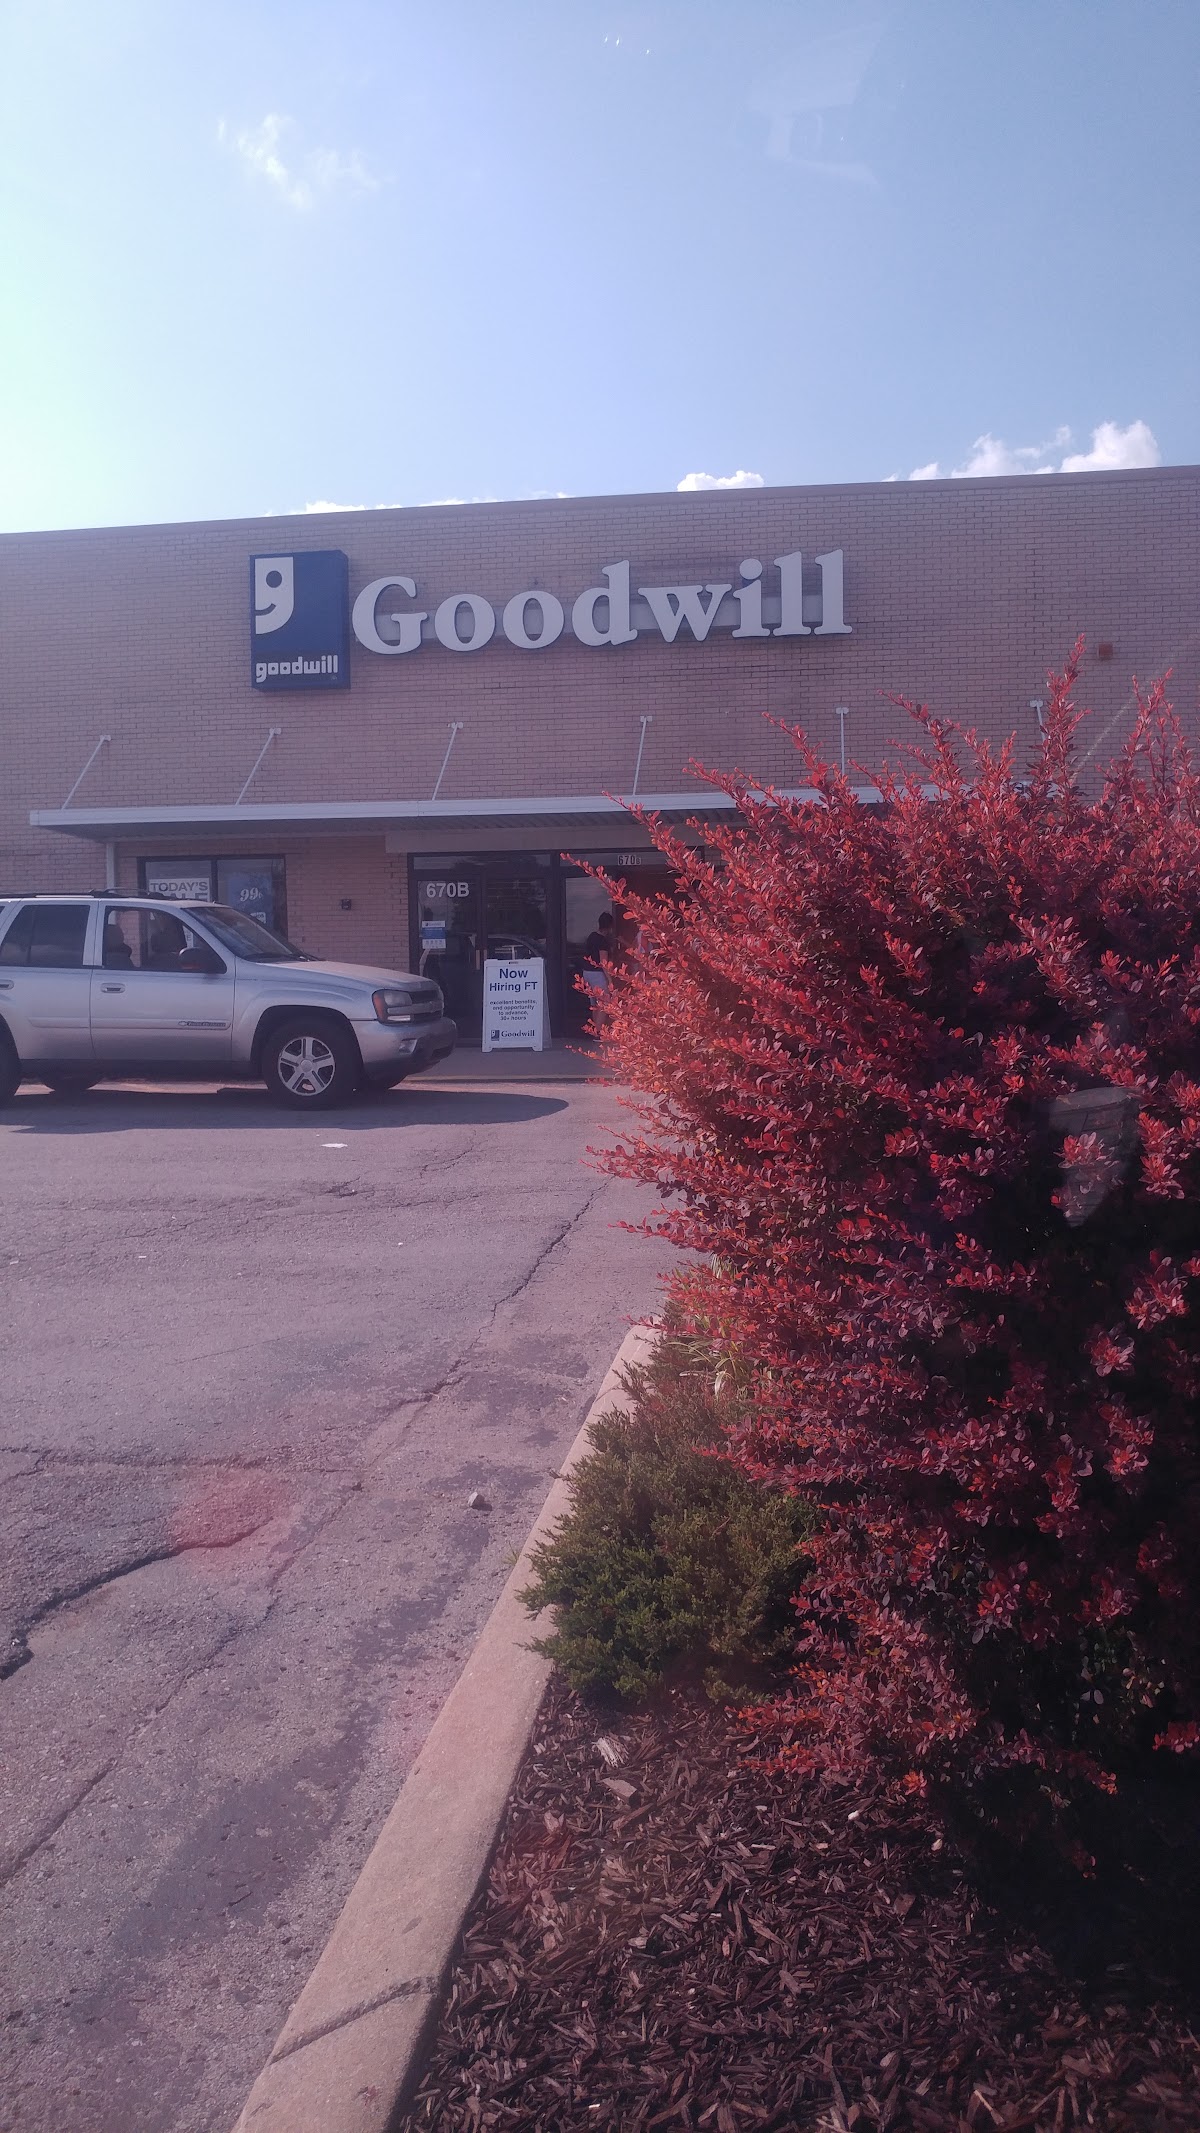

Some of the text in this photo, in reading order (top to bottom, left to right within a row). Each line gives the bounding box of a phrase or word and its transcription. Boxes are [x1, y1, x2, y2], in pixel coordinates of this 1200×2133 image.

[352, 549, 853, 655] Goodwill
[255, 655, 339, 683] goodwill
[150, 881, 208, 892] TODAY'S
[426, 882, 470, 898] 670B
[499, 968, 529, 979] Now
[489, 981, 538, 993] Hiring FT
[501, 1029, 535, 1038] Goodwill
